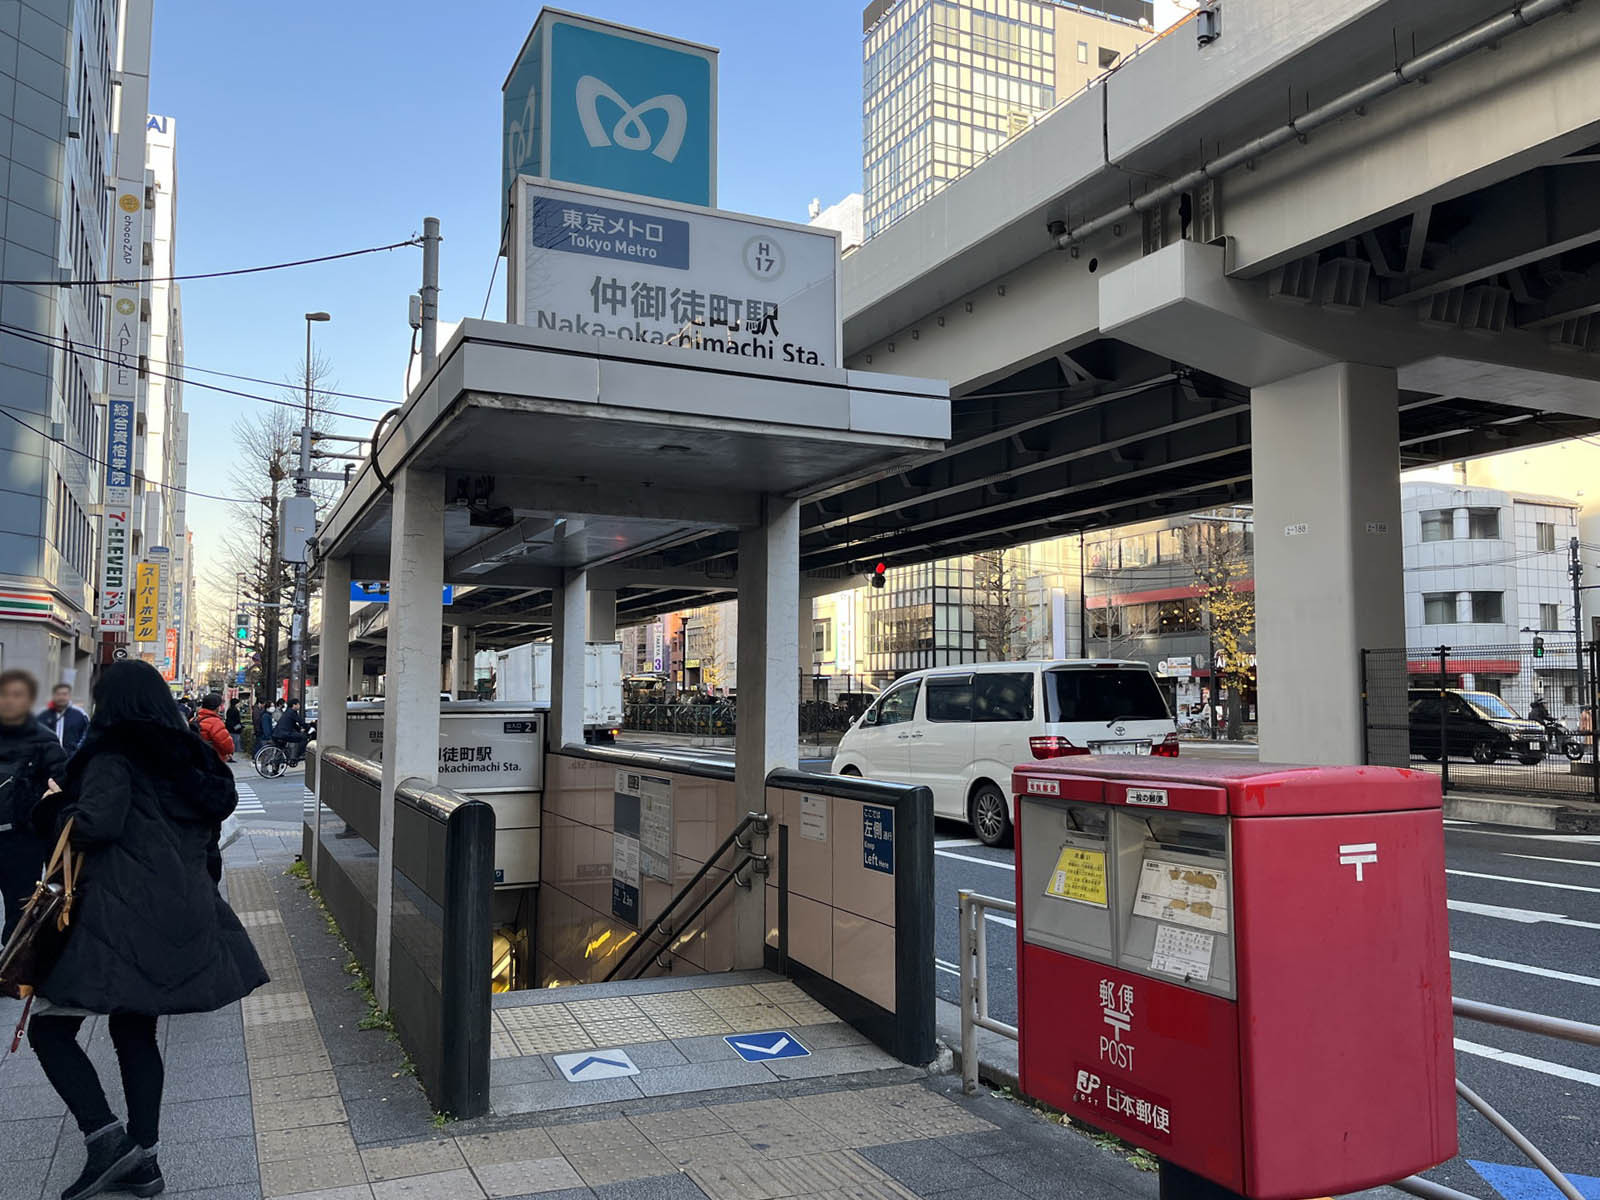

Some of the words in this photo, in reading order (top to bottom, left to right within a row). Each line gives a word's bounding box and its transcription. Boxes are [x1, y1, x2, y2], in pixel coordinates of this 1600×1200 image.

[123, 215, 133, 264] chocoZAP
[562, 208, 664, 243] 東京メトロ
[568, 232, 611, 254] Tokyo
[615, 238, 657, 259] Metro
[758, 242, 769, 256] H
[755, 257, 774, 272] 17
[590, 275, 779, 337] 仲御徒町駅
[117, 322, 131, 386] APRE
[783, 342, 825, 366] Sta.
[139, 567, 154, 637] スーパーホテル
[655, 659, 661, 670] 3
[525, 722, 532, 732] 2
[503, 761, 521, 772] Sta.
[865, 852, 879, 866] Left
[1100, 979, 1134, 1016] 郵便
[1100, 1036, 1135, 1071] POST
[1106, 1085, 1170, 1134] 日本郵便
